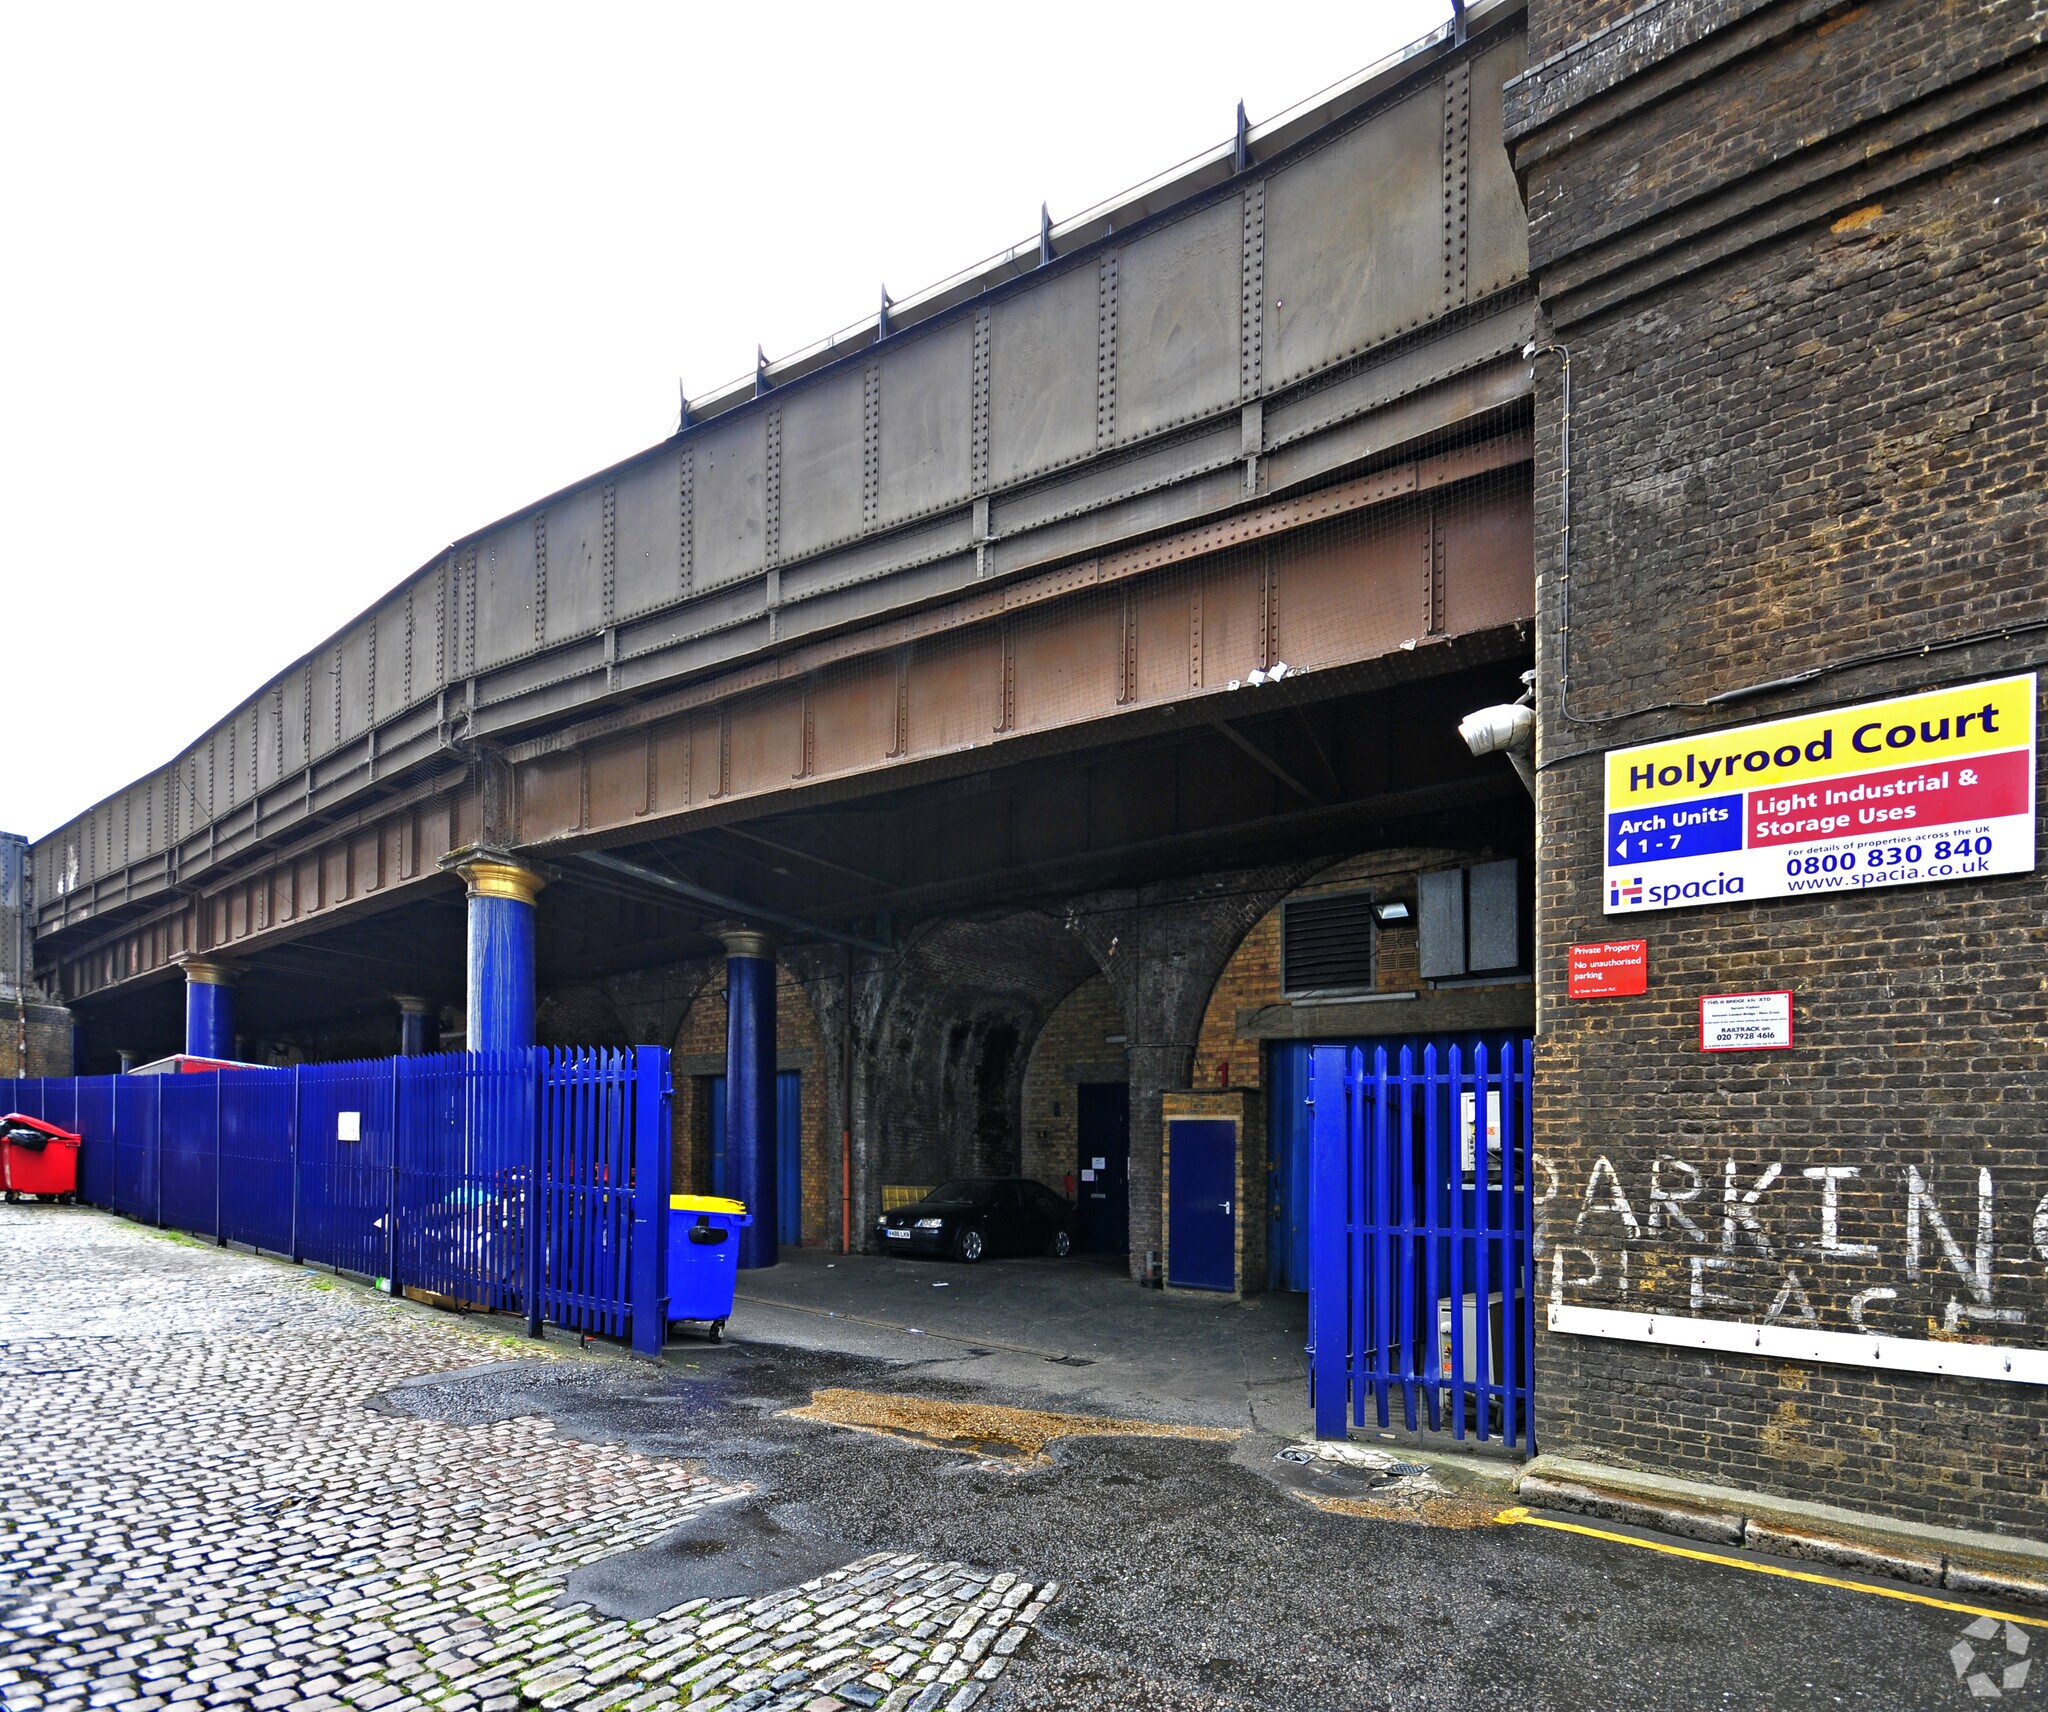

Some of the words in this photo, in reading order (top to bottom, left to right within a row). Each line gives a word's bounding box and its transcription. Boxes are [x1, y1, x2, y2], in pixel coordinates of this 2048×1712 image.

[1630, 730, 1833, 788] Holyrood
[1852, 703, 2000, 753] Court
[1756, 791, 1817, 816] Light
[1825, 771, 1949, 806] Industrial
[1958, 768, 1979, 786] &
[1618, 814, 1666, 835] Arch
[1672, 807, 1729, 827] Units
[1756, 813, 1850, 838] Storage
[1858, 804, 1917, 825] Uses
[1638, 838, 1648, 854] 1
[1670, 834, 1682, 850] 7
[1806, 844, 1840, 854] details
[1843, 842, 1855, 850] of
[1857, 835, 1912, 849] properties
[1915, 831, 1950, 841] across
[1953, 828, 1972, 837] the
[1976, 825, 1991, 834] UK
[1786, 853, 1856, 877] 0800
[1867, 844, 1923, 867] 830
[1934, 836, 1993, 860] 840
[1788, 857, 1990, 891] www.spacia.co.uk
[1649, 872, 1744, 906] spacia
[1574, 947, 1601, 955] Private
[1604, 944, 1640, 953] Property
[1574, 961, 1587, 969] No
[1590, 957, 1642, 968] unauthorised
[1574, 972, 1603, 982] parking
[1716, 1033, 1731, 1041] 020
[1735, 1032, 1754, 1040] 7928
[1757, 1031, 1775, 1039] 4616
